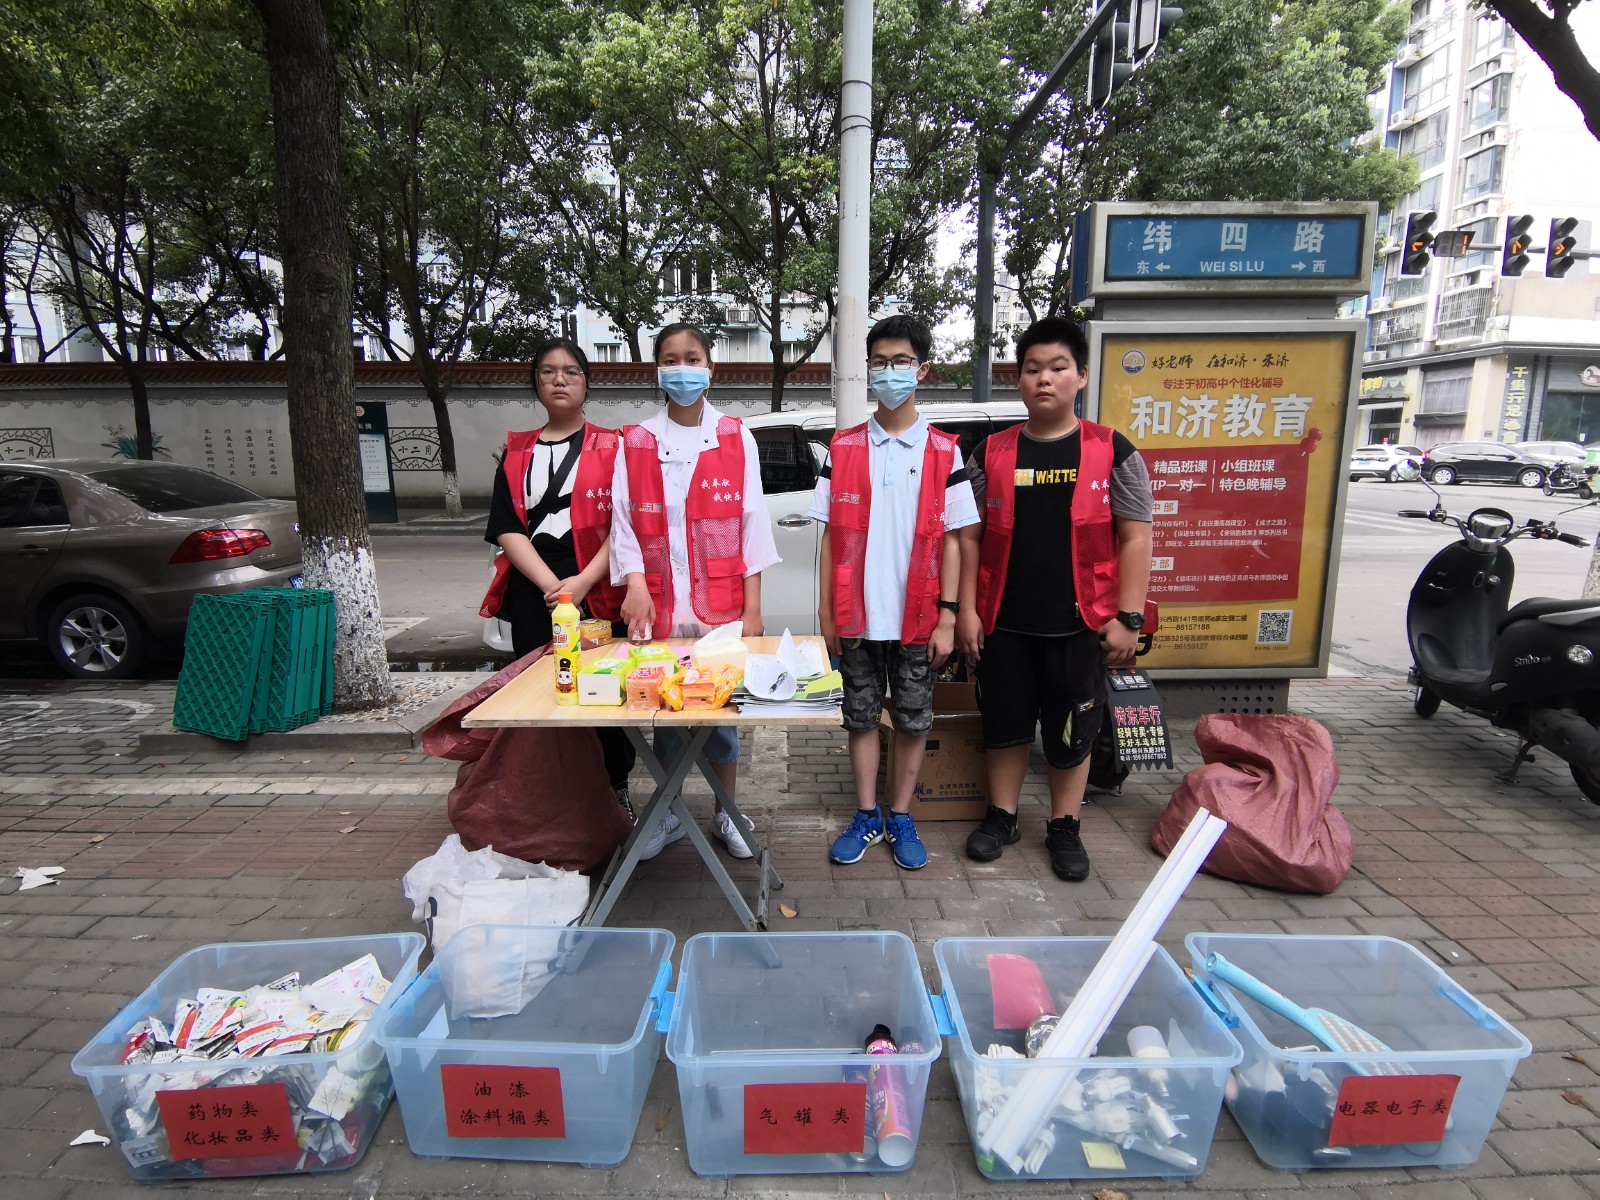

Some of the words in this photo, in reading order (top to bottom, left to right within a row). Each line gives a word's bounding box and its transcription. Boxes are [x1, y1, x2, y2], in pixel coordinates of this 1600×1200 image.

[1142, 221, 1325, 254] 纬四路
[1137, 261, 1150, 275] 东
[1200, 261, 1225, 272] WEI
[1229, 261, 1243, 272] SI
[1246, 260, 1265, 272] LU
[1312, 259, 1327, 273] 西
[1151, 353, 1194, 370] 好老师
[1162, 377, 1284, 390] 专注于初高中个性化辅导
[1130, 393, 1314, 439] 和济教育
[4, 446, 35, 457] 十一月
[398, 445, 432, 456] 十二月
[1153, 460, 1208, 474] 精品班课
[1220, 459, 1275, 473] 小组班课
[700, 478, 731, 490] 我奉献
[1035, 468, 1078, 486] WHITE
[1219, 477, 1287, 492] 特色晚辅导
[712, 491, 742, 502] 我快乐
[475, 1081, 531, 1099] 油漆
[188, 1100, 259, 1122] 药物类
[1338, 1098, 1449, 1117] 电器电子类
[460, 1108, 550, 1127] 涂料桶类
[759, 1106, 850, 1126] 气罐类
[183, 1125, 280, 1146] 化妆品类
